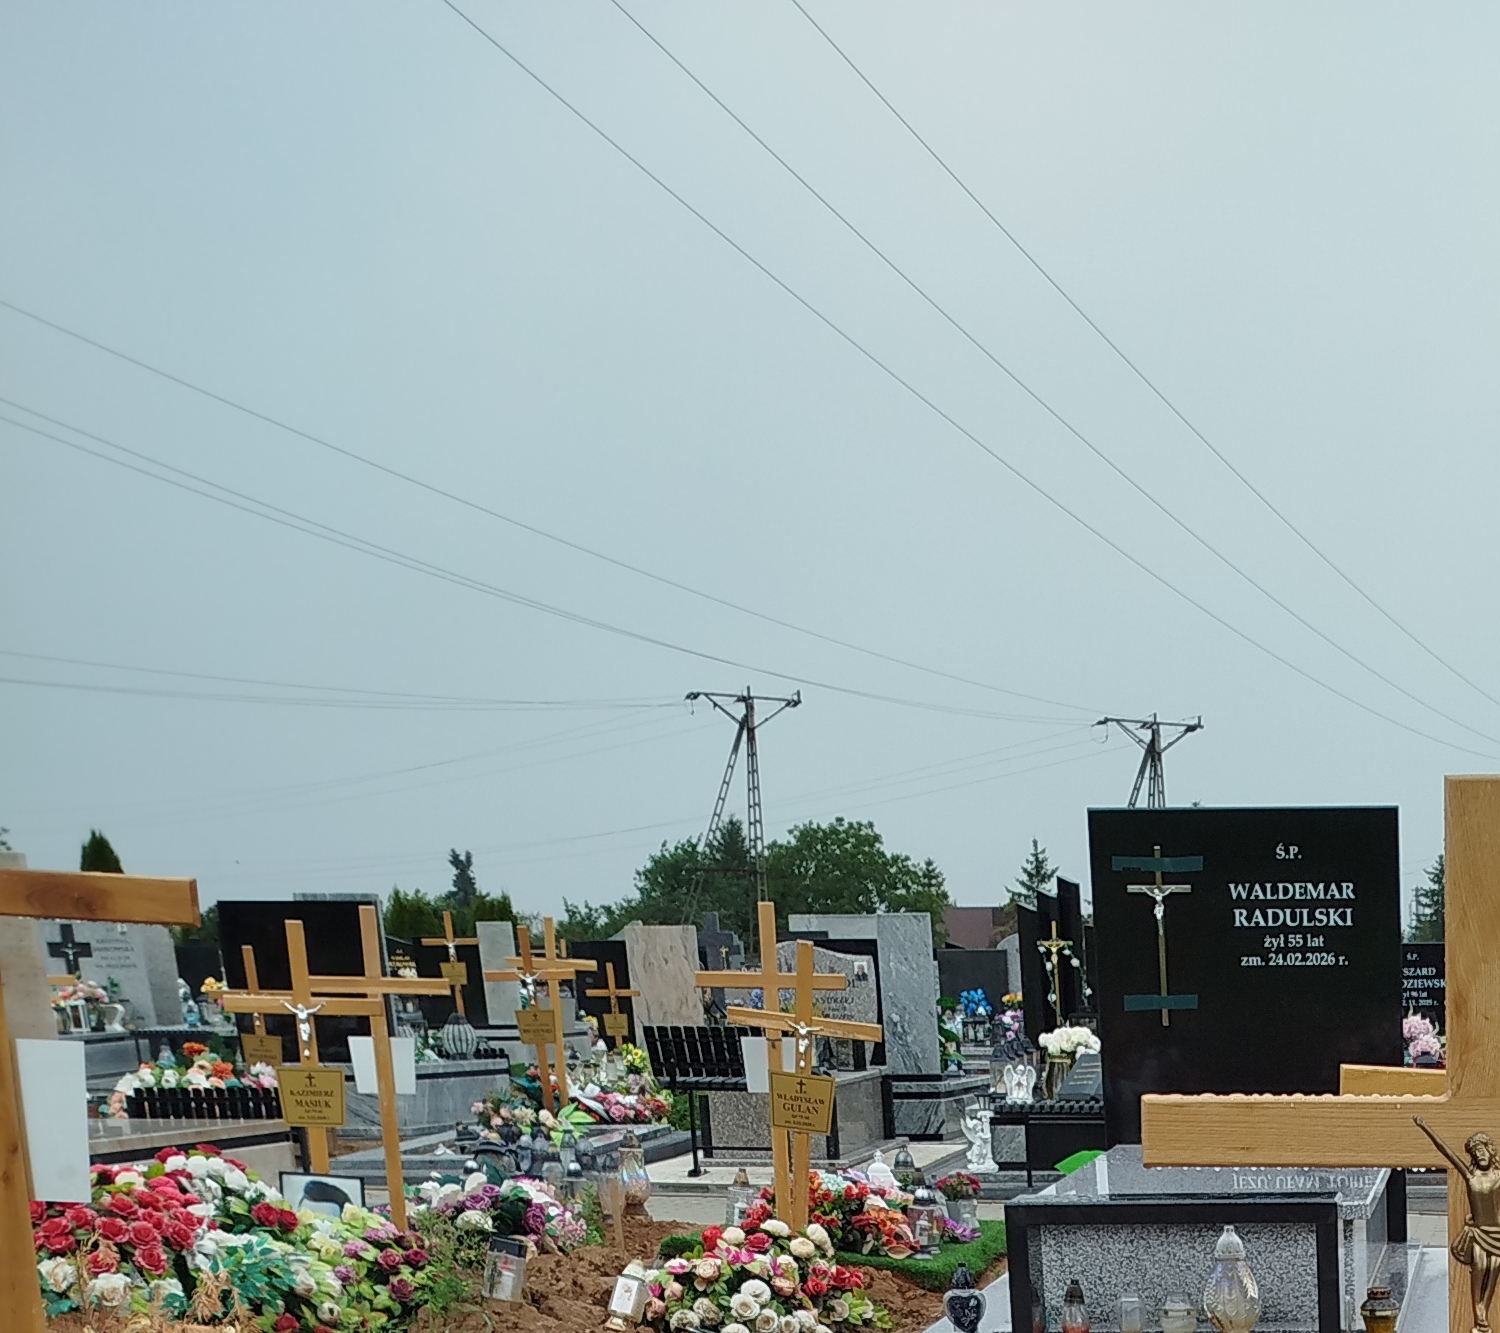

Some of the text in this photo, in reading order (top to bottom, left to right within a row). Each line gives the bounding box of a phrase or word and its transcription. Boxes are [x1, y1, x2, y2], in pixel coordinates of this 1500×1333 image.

[1228, 882, 1356, 900] WALDEMAR
[1232, 907, 1354, 927] RADULSKI
[1263, 933, 1325, 951] żył 55 lat
[1240, 952, 1349, 966] zm. 24.02.2026 r.
[782, 1102, 820, 1115] GULAN
